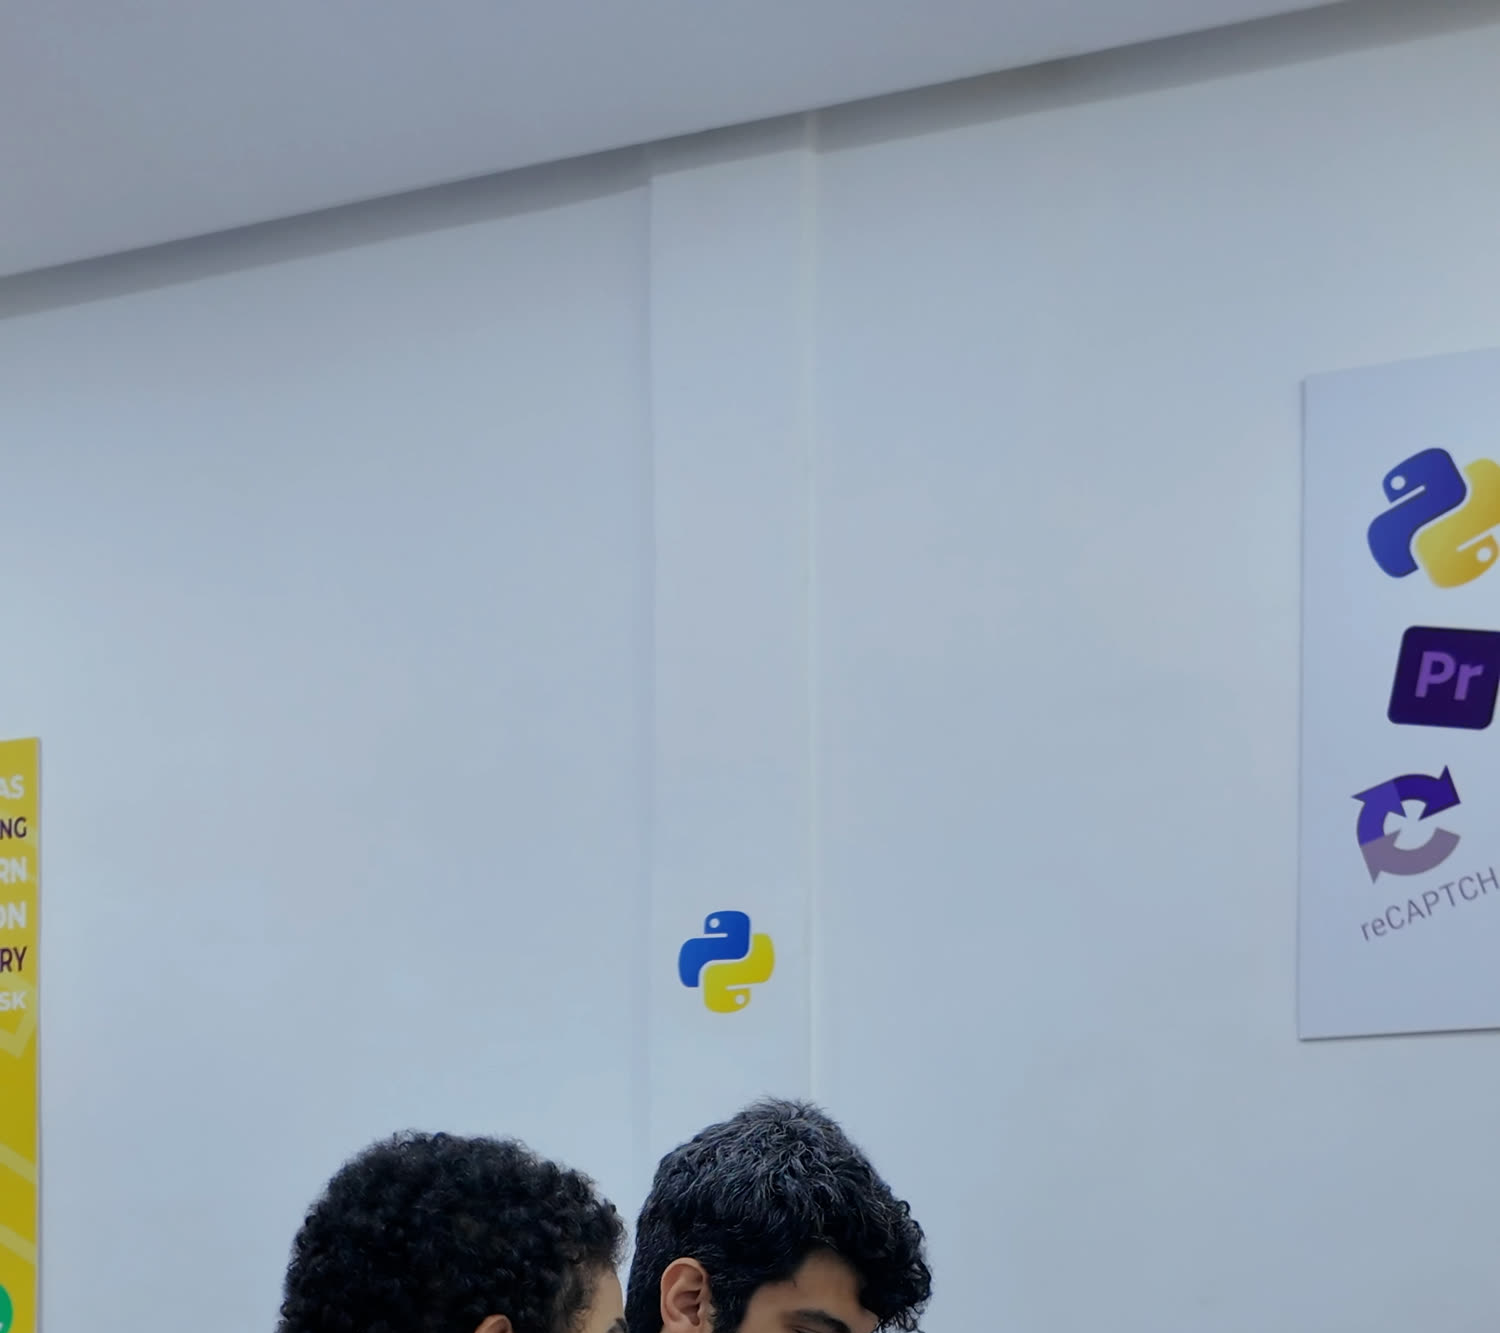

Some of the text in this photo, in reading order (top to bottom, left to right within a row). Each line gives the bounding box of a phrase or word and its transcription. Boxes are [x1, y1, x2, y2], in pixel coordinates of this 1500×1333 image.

[1415, 651, 1484, 701] Pr
[1360, 866, 1500, 942] reCAPTCH
[0, 945, 27, 974] RY
